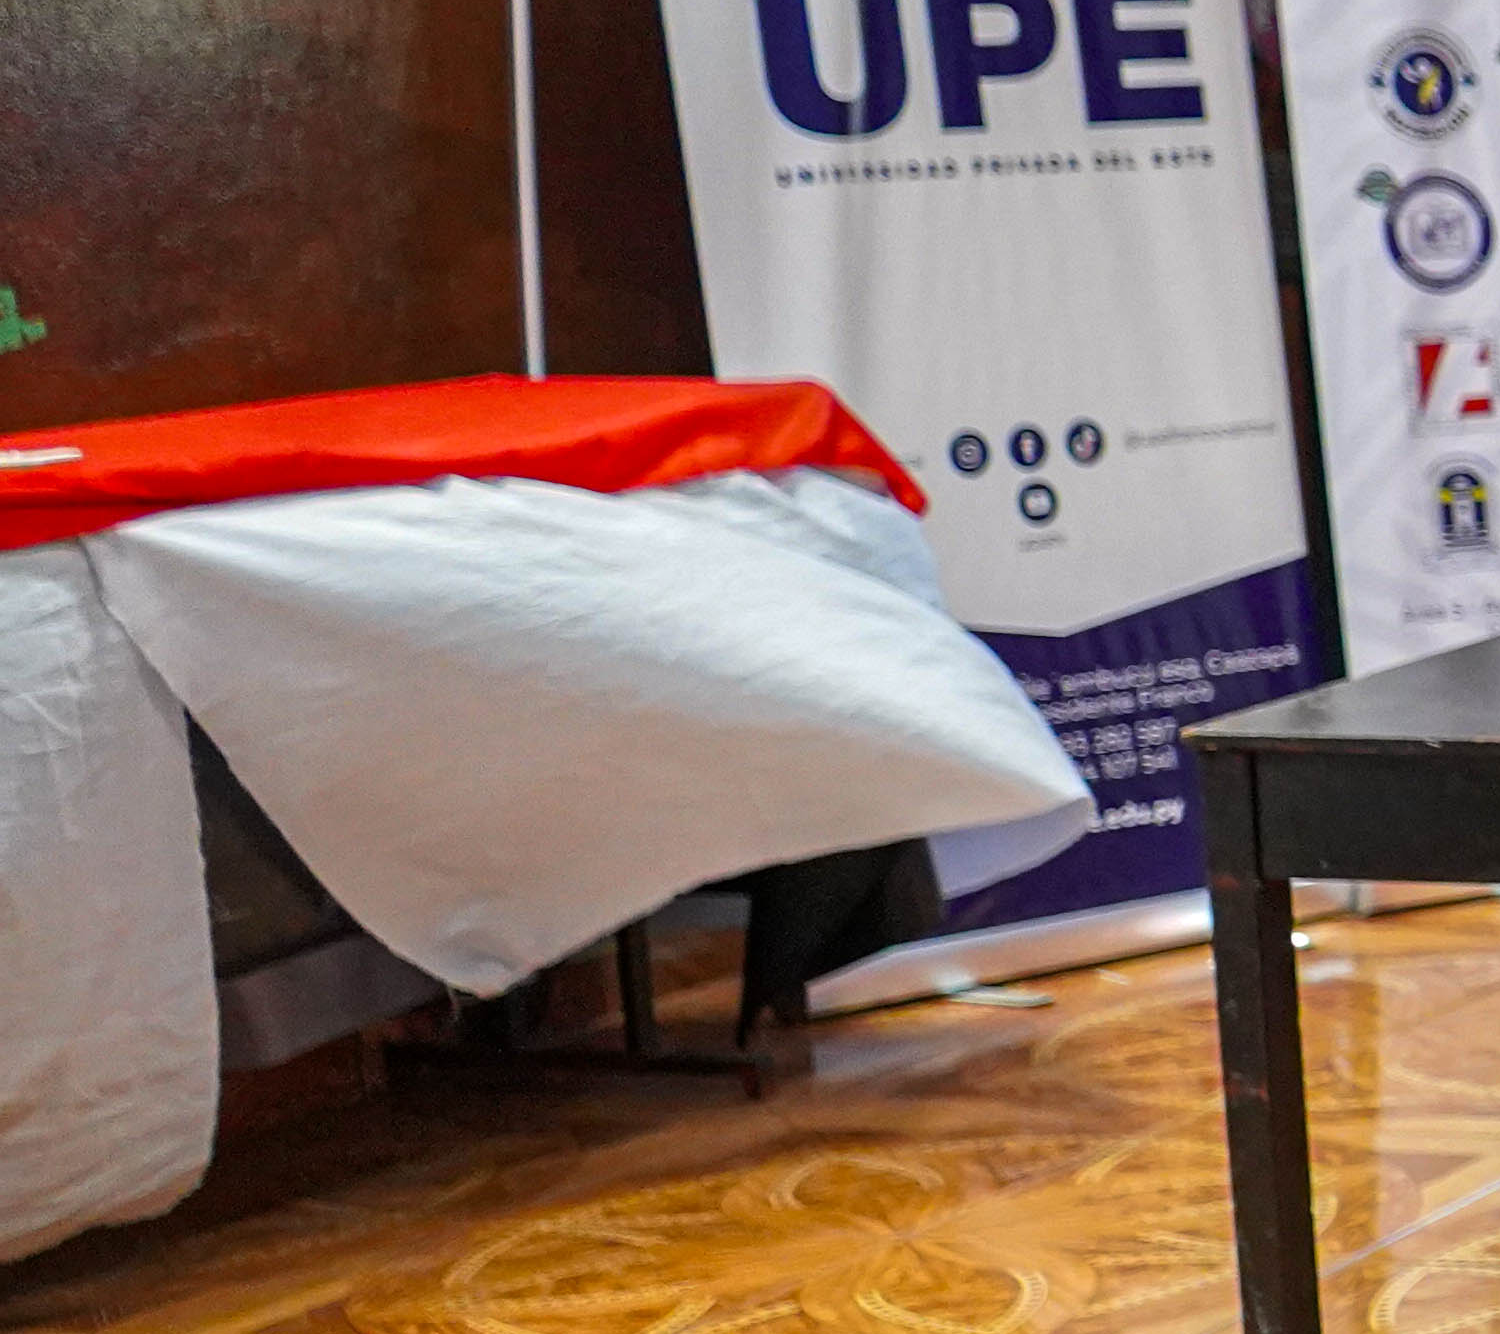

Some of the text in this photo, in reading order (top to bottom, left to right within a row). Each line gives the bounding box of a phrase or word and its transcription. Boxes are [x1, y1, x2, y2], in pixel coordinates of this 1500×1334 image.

[776, 145, 1215, 189] UNIVERSIDAD PRIVADA DEL ESTE
